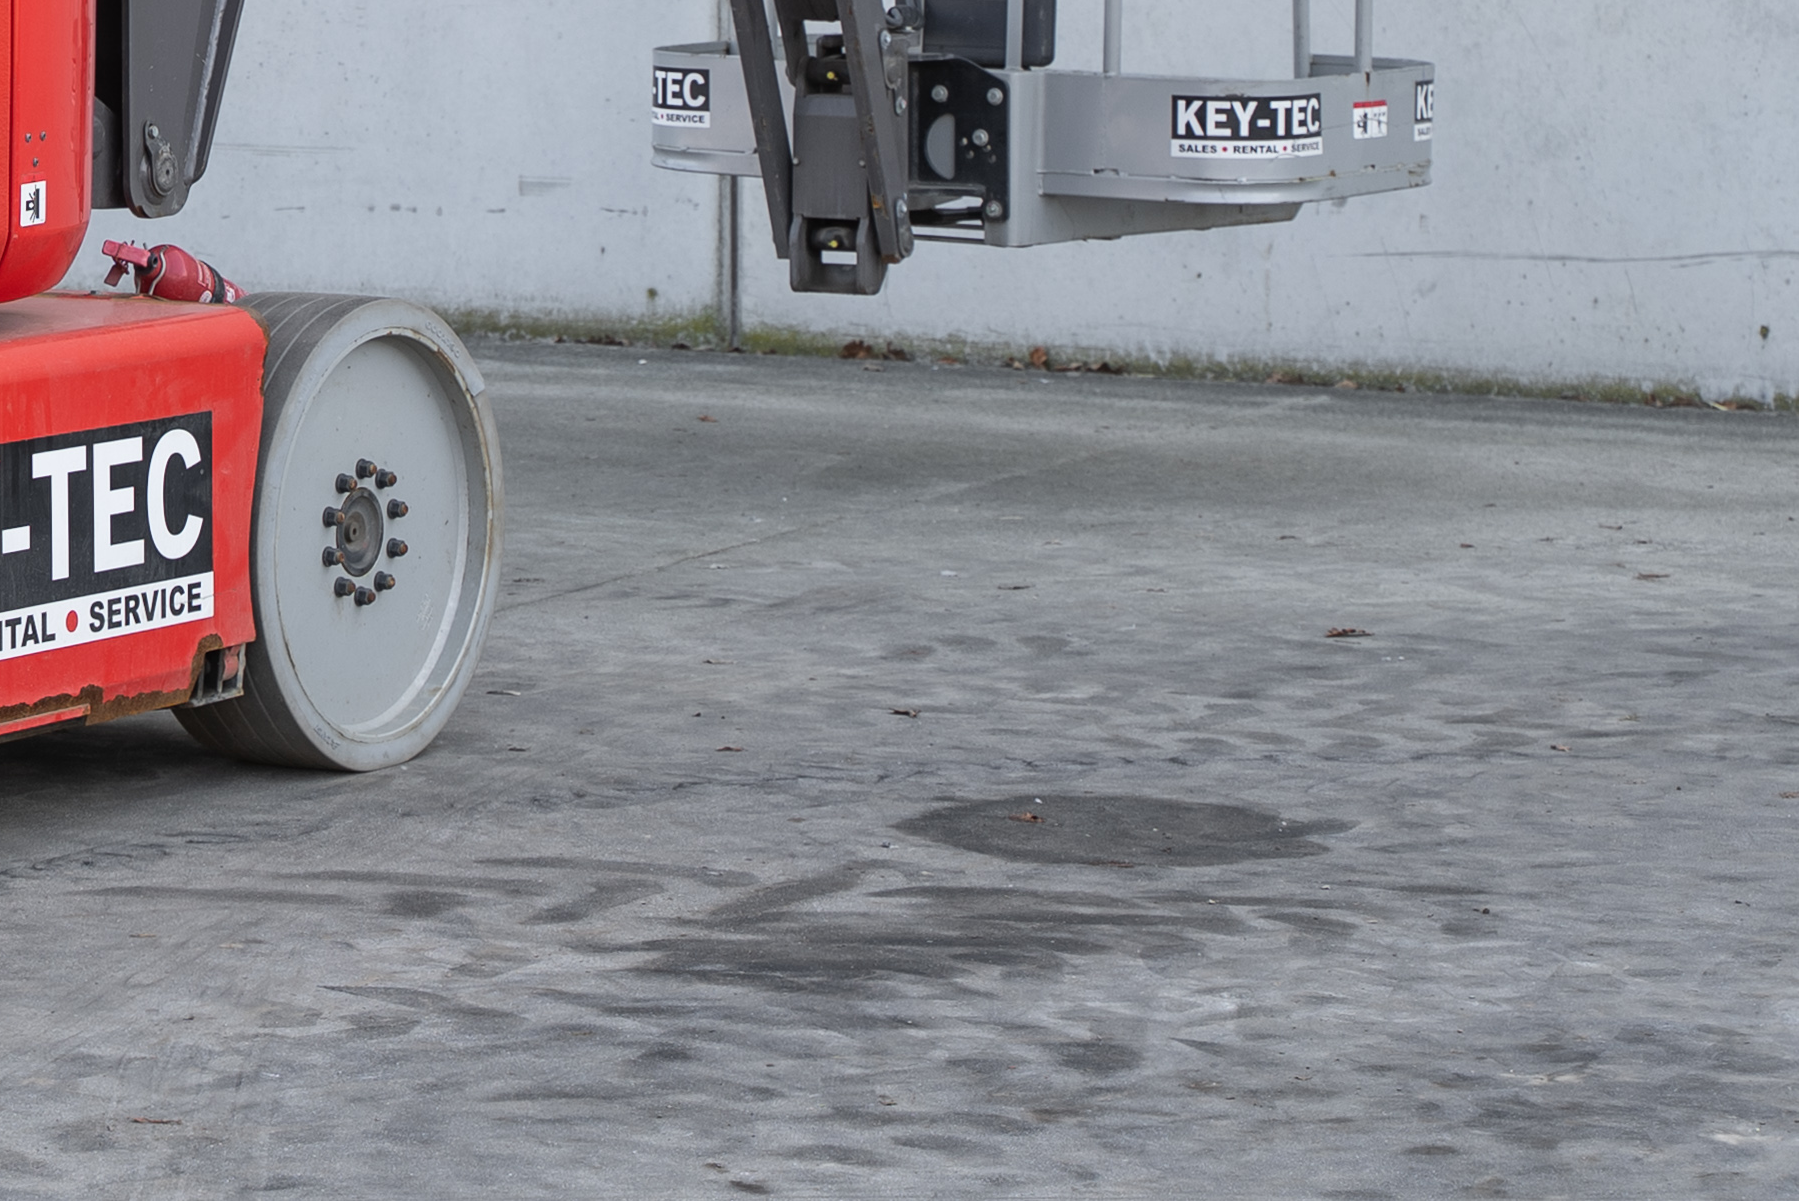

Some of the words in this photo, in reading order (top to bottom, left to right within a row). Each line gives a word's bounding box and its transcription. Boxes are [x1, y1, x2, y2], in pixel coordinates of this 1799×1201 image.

[666, 113, 705, 124] SERVICE
[1176, 97, 1320, 137] KEY-TEC
[1178, 143, 1217, 154] SALES
[1233, 145, 1279, 154] RENTAL
[1291, 140, 1320, 153] SERVICE
[89, 582, 202, 633] SERVICE
